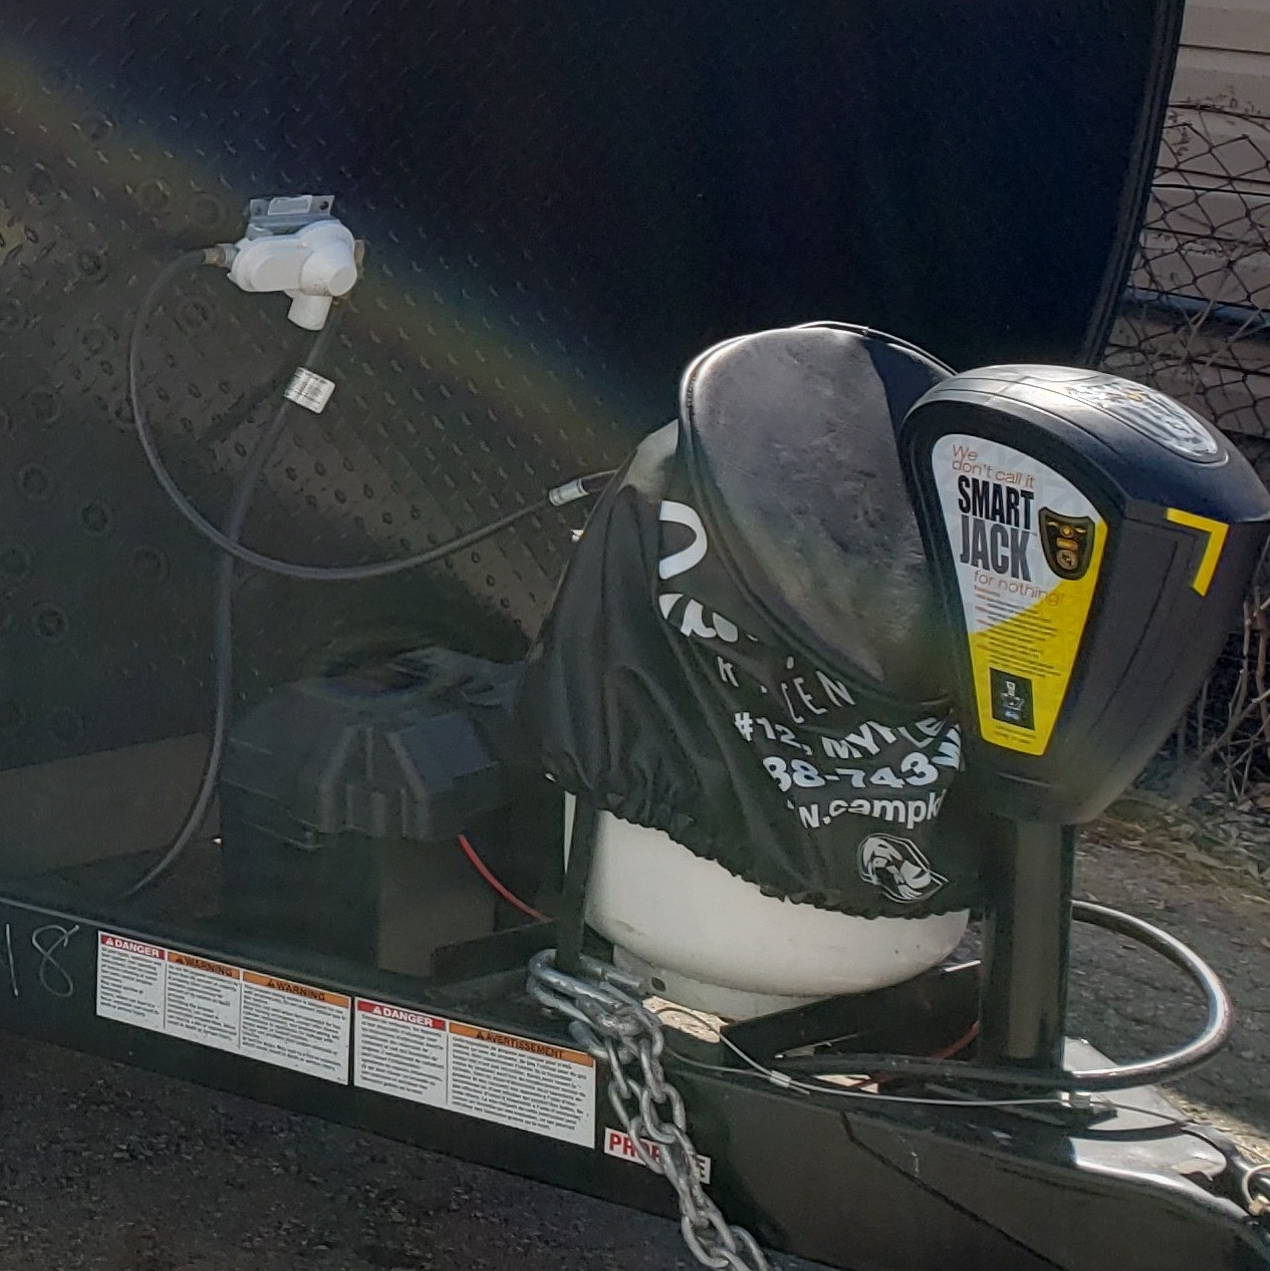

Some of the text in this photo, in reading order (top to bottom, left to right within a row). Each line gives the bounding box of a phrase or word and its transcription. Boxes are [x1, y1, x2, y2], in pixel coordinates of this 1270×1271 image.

[952, 444, 978, 461] We
[952, 458, 1036, 488] don't call it
[958, 475, 1035, 529] SMART
[960, 514, 1032, 582] JACK
[974, 571, 993, 585] for
[114, 939, 160, 958] DANGER
[277, 982, 326, 1001] WARNING
[382, 1007, 434, 1028] DANGER
[486, 1032, 563, 1060] AVERTISSEMENT
